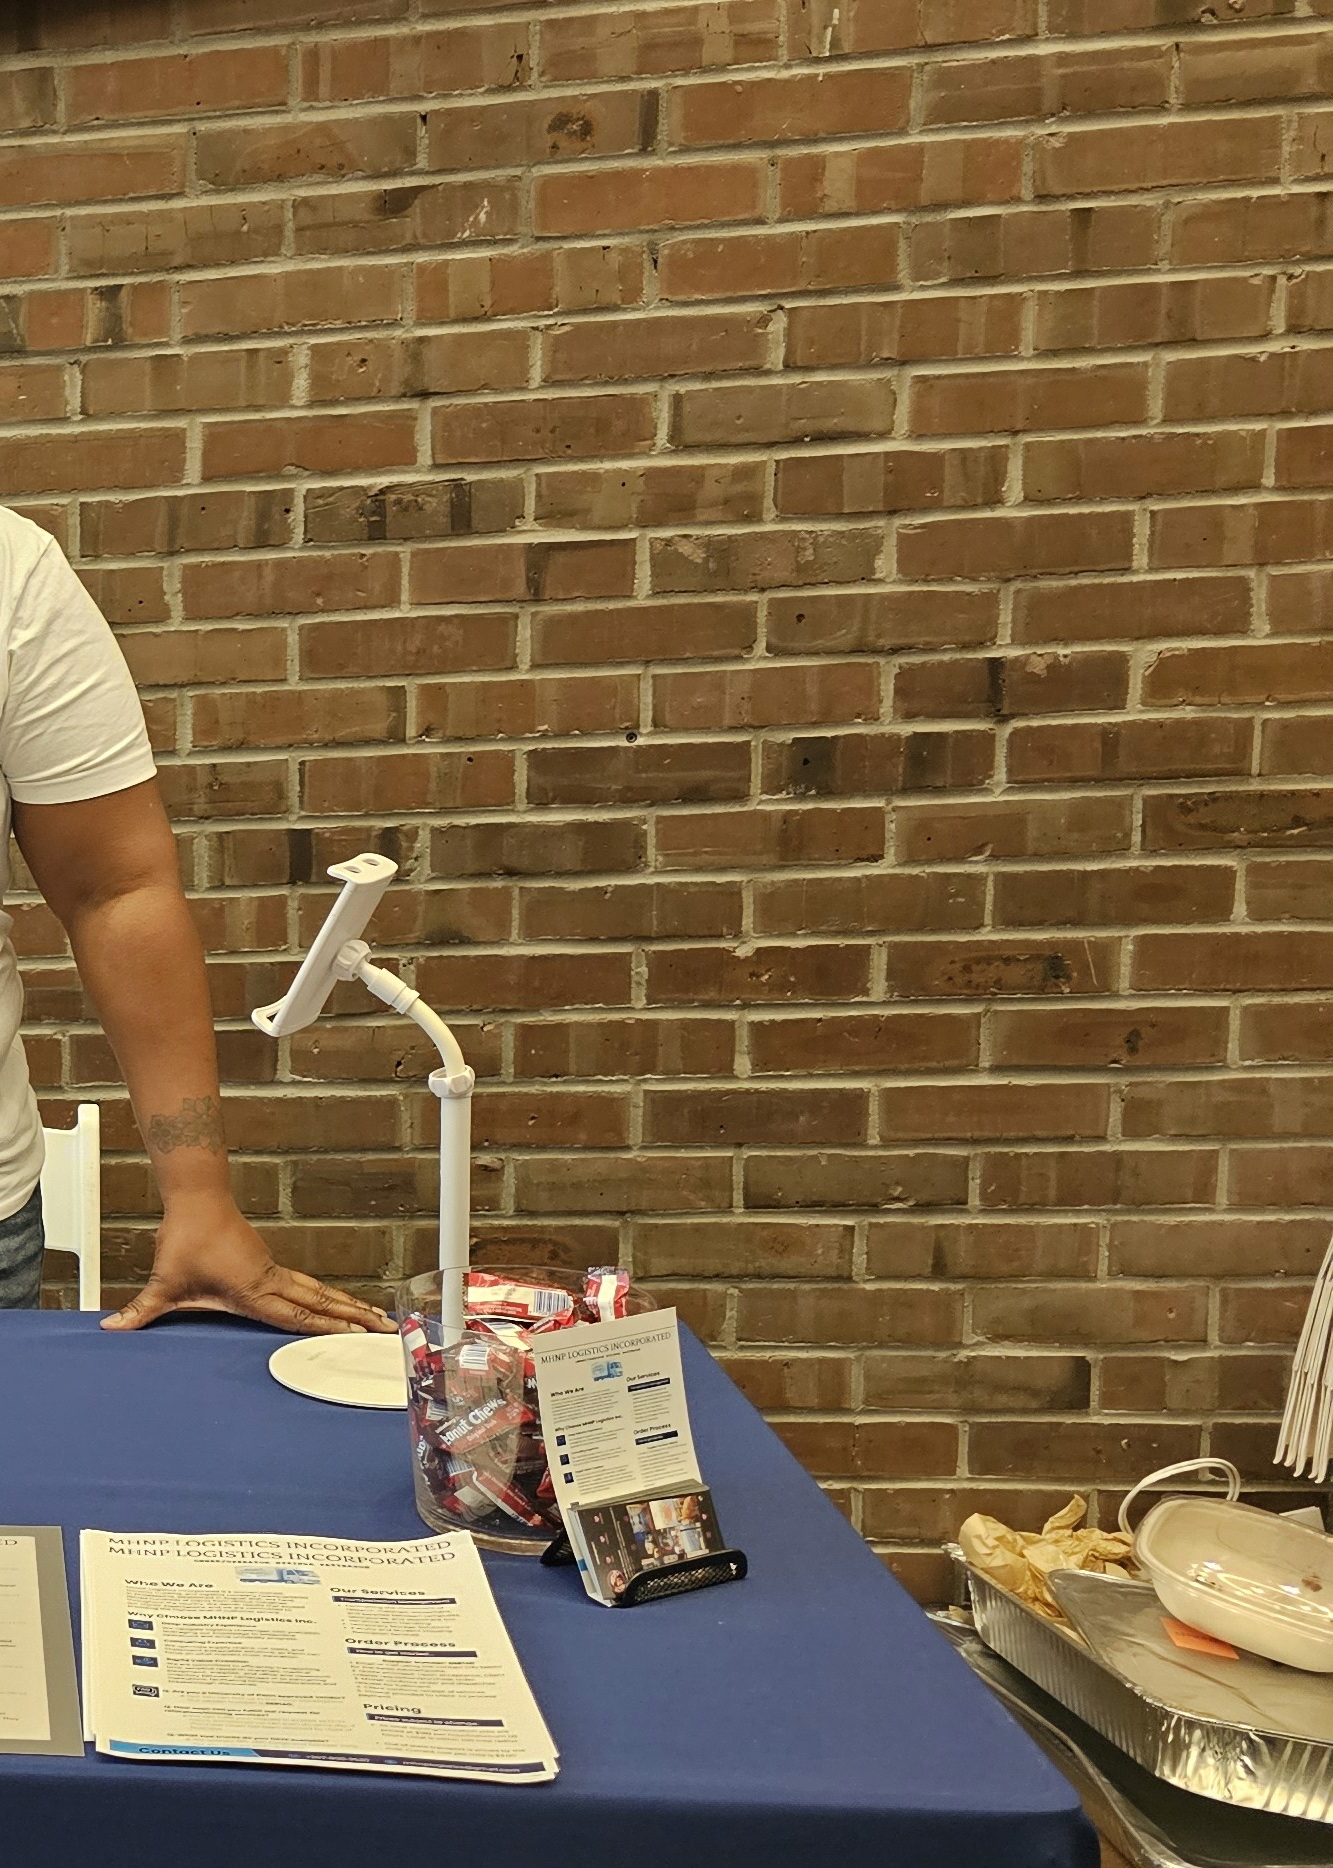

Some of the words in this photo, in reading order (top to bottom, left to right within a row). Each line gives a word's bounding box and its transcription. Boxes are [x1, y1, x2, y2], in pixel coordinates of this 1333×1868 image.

[540, 1354, 566, 1364] MHNP
[567, 1345, 610, 1360] LOGISTICS
[610, 1332, 671, 1351] INCORPORATED
[469, 1399, 507, 1425] Chews
[108, 1538, 170, 1546] MHNP
[176, 1540, 280, 1549] LOGISTICS
[285, 1540, 451, 1554] INCORPORATED
[109, 1547, 170, 1556] MHNP
[176, 1550, 283, 1560] LOGISTICS
[288, 1552, 456, 1566] INCORPORATED
[125, 1579, 159, 1588] Who
[240, 1616, 293, 1625] Logistics
[345, 1638, 390, 1646] Order
[393, 1639, 456, 1647] Process
[363, 1703, 422, 1714] Pricing
[138, 1747, 206, 1757] Contact
